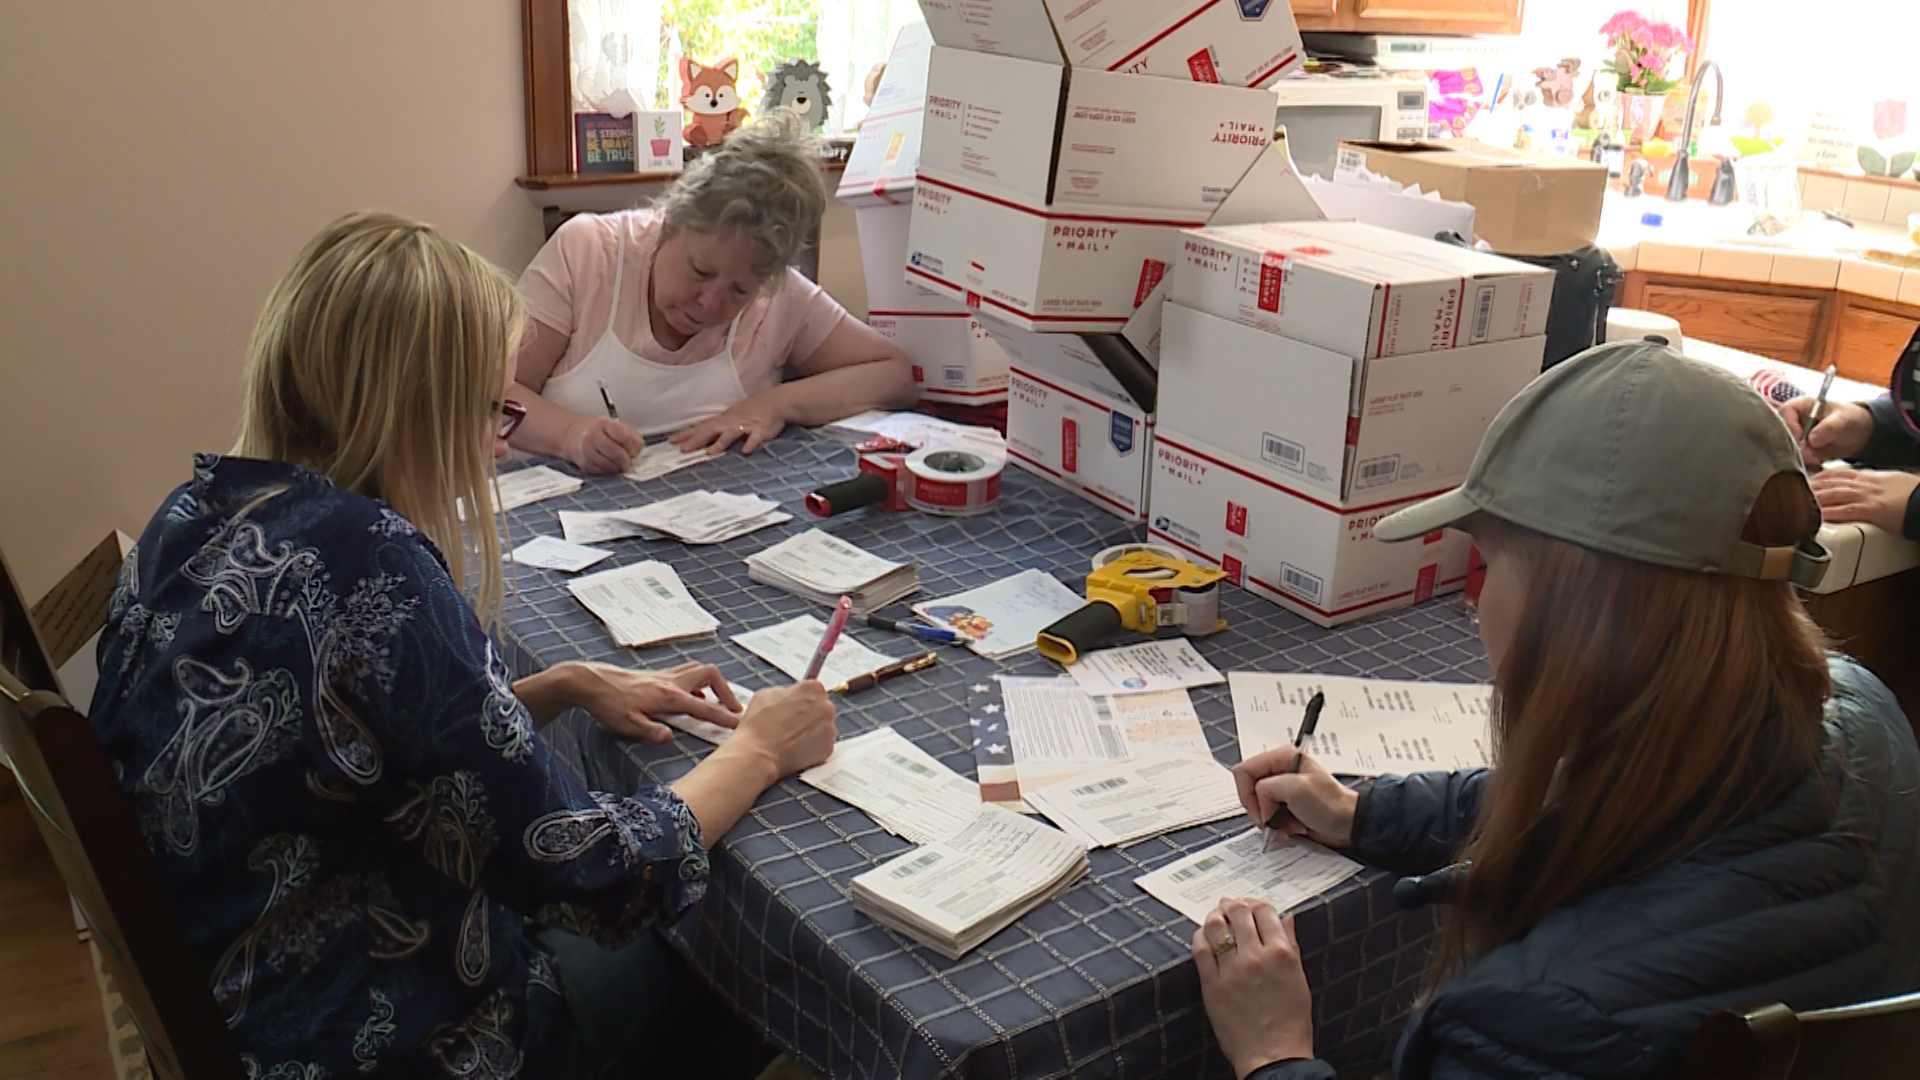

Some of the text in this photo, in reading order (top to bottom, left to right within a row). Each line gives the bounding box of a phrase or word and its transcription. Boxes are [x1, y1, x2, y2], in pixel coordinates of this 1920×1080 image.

[929, 95, 962, 110] PRIORITY
[1229, 121, 1257, 132] MAIL
[586, 138, 599, 151] BE
[1211, 131, 1267, 147] PRIORITY
[587, 149, 634, 163] BE TRUE
[917, 186, 951, 204] PRIORITY
[1053, 225, 1116, 240] PRIORITY
[1066, 241, 1099, 252] MAIL
[1184, 241, 1232, 262] PRIORITY
[1194, 257, 1219, 272] MAIL
[1011, 377, 1049, 399] PRIORITY
[1019, 391, 1039, 408] MAIL
[1158, 448, 1208, 476] PRIORITY
[1169, 467, 1193, 484] MAIL
